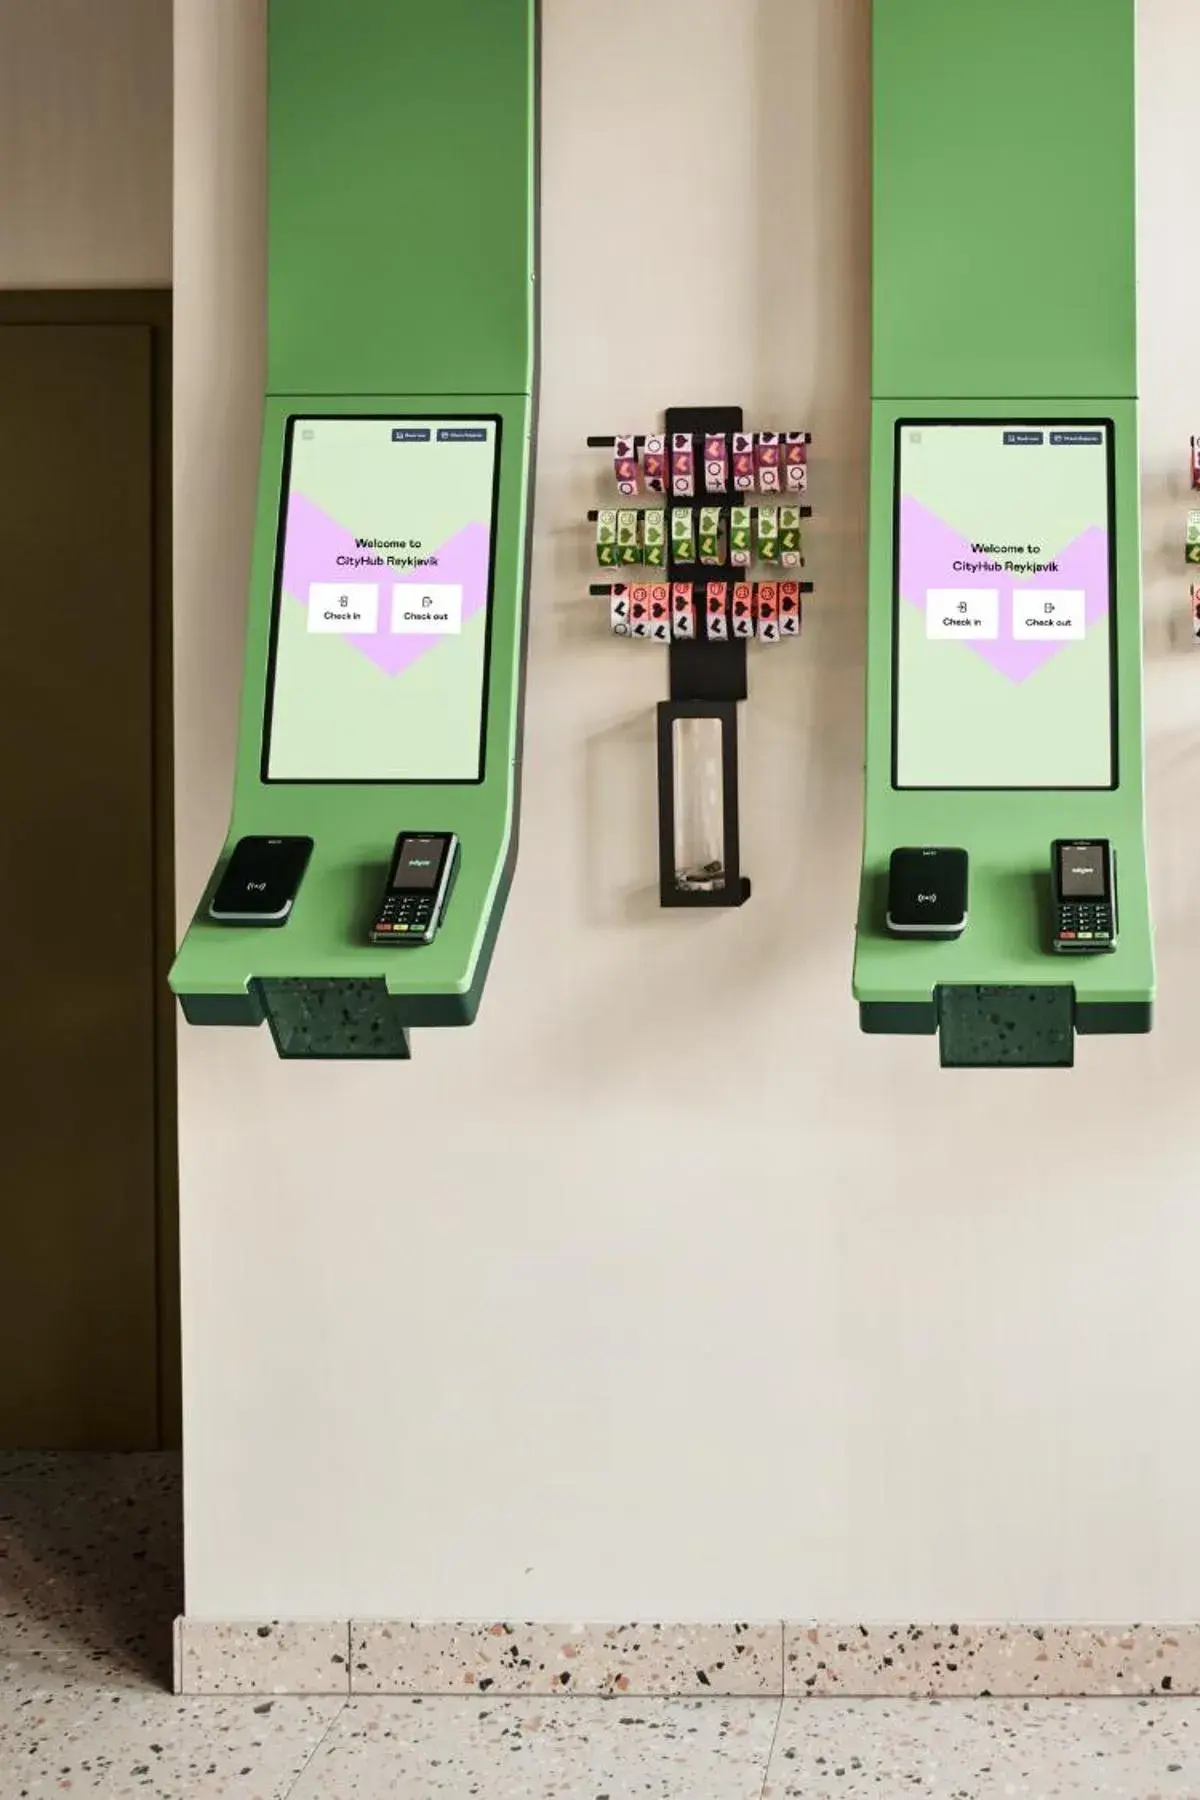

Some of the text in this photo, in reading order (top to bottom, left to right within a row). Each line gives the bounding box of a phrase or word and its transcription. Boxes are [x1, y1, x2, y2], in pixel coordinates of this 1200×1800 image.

[355, 539, 421, 548] Welcome to
[971, 544, 1040, 554] Welcome to
[336, 556, 439, 568] CityHub Reykjavik
[953, 561, 1059, 574] CityHub Reykjavik
[324, 611, 361, 620] Check in
[404, 612, 431, 620] Check
[943, 617, 971, 626] Check
